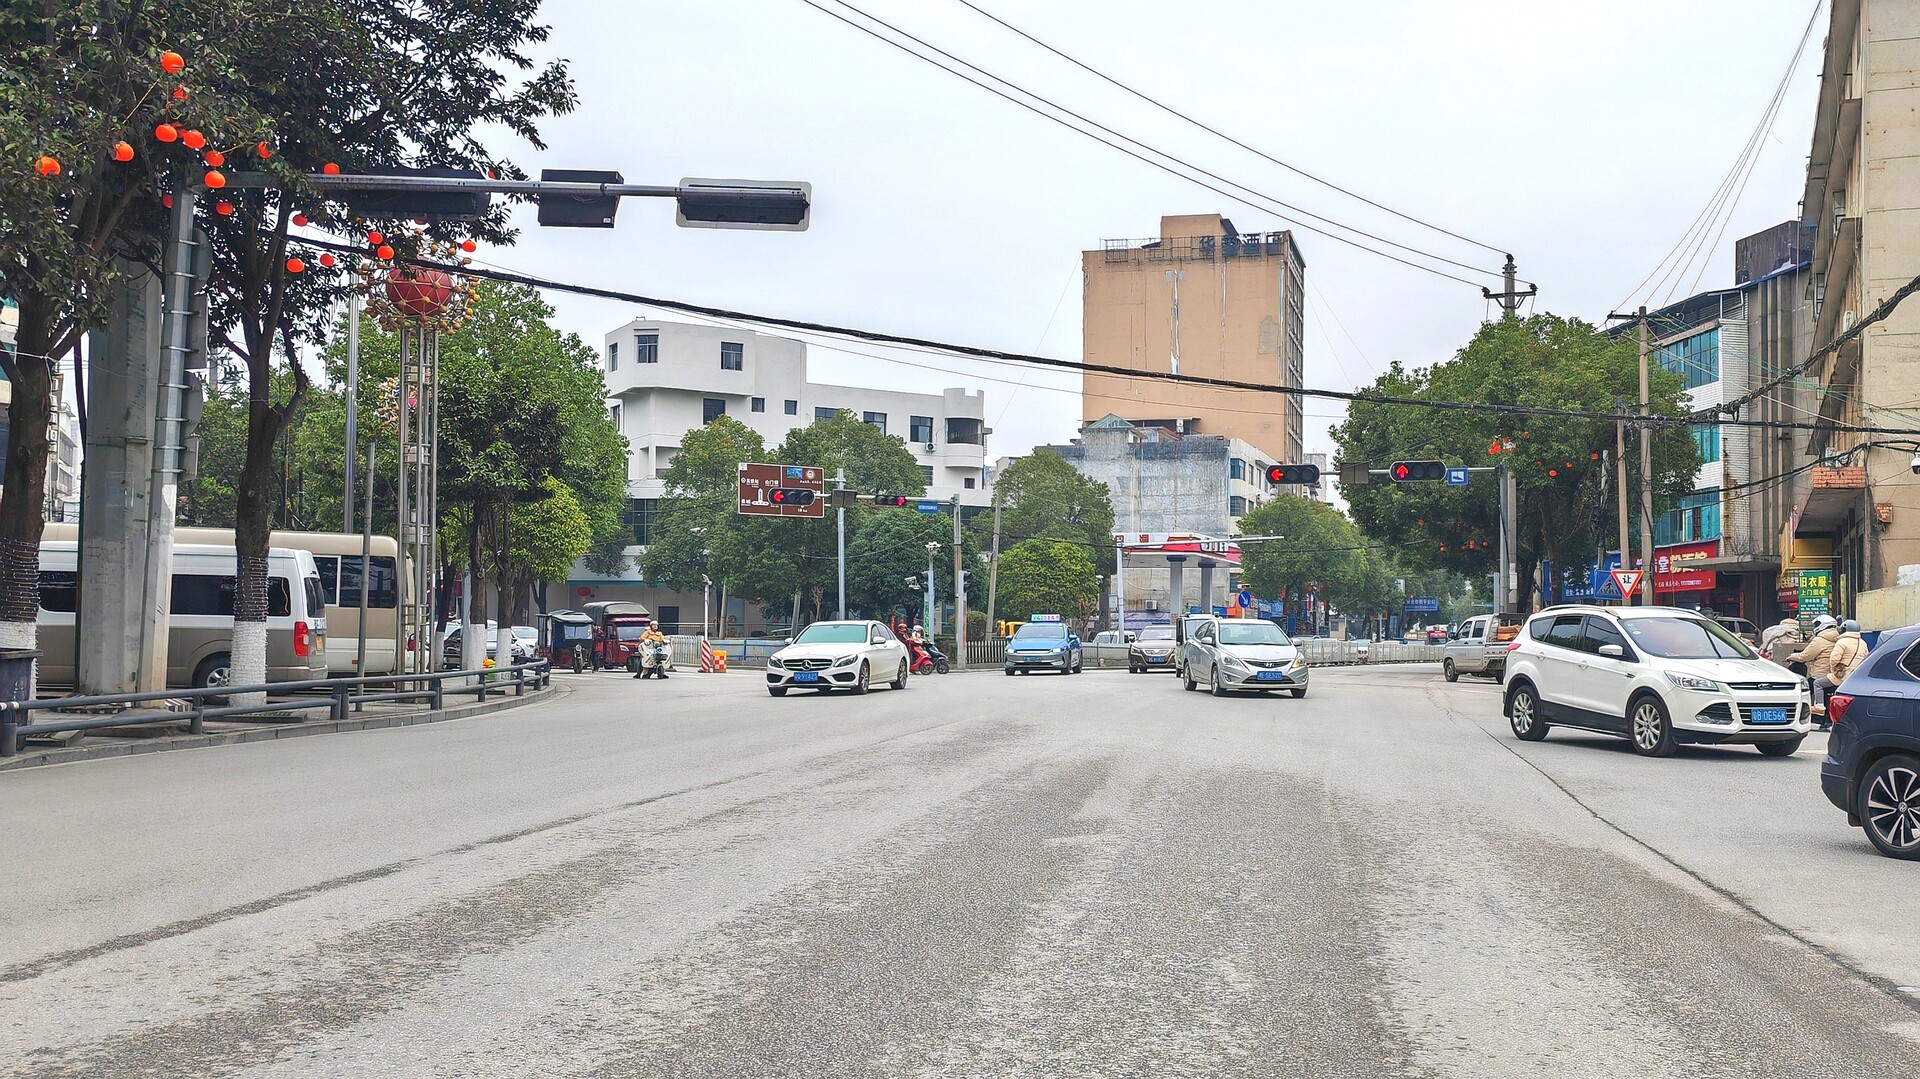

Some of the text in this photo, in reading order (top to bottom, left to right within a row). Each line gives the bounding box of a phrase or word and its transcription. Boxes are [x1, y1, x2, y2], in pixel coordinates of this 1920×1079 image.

[1622, 575, 1632, 584] 让
[1799, 576, 1826, 588] 旧衣服
